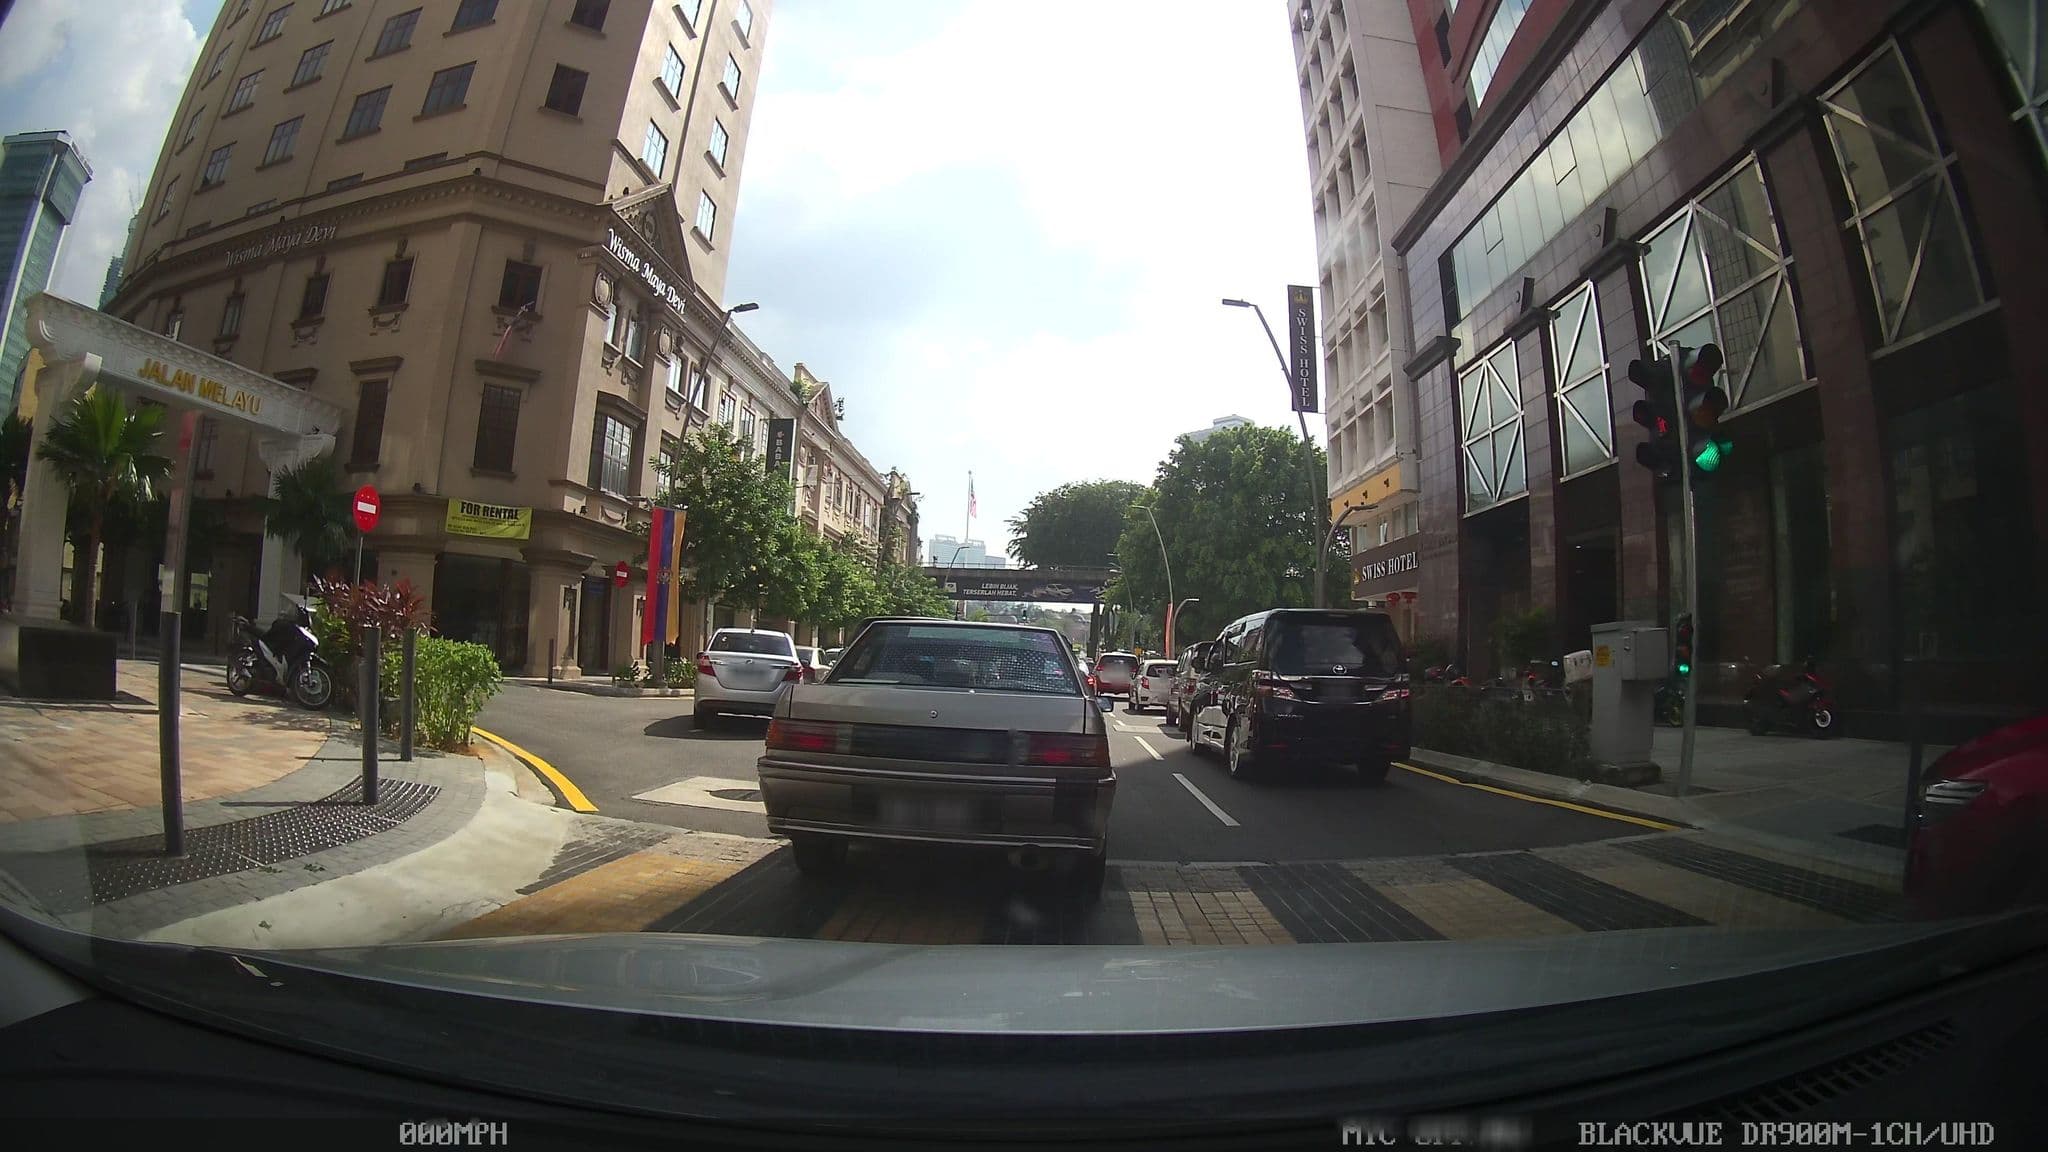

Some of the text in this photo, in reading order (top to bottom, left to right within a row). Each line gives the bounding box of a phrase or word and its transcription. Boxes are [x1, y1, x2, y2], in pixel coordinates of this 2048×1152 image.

[225, 225, 337, 267] Wisma Maya Devi
[608, 228, 687, 315] Wisma Maya Devi
[1296, 308, 1311, 407] SWISS HOTEL
[138, 357, 262, 416] JALAN MELAYU
[460, 501, 520, 520] FOR RENTAL
[1361, 551, 1419, 582] SWISS HOTEL
